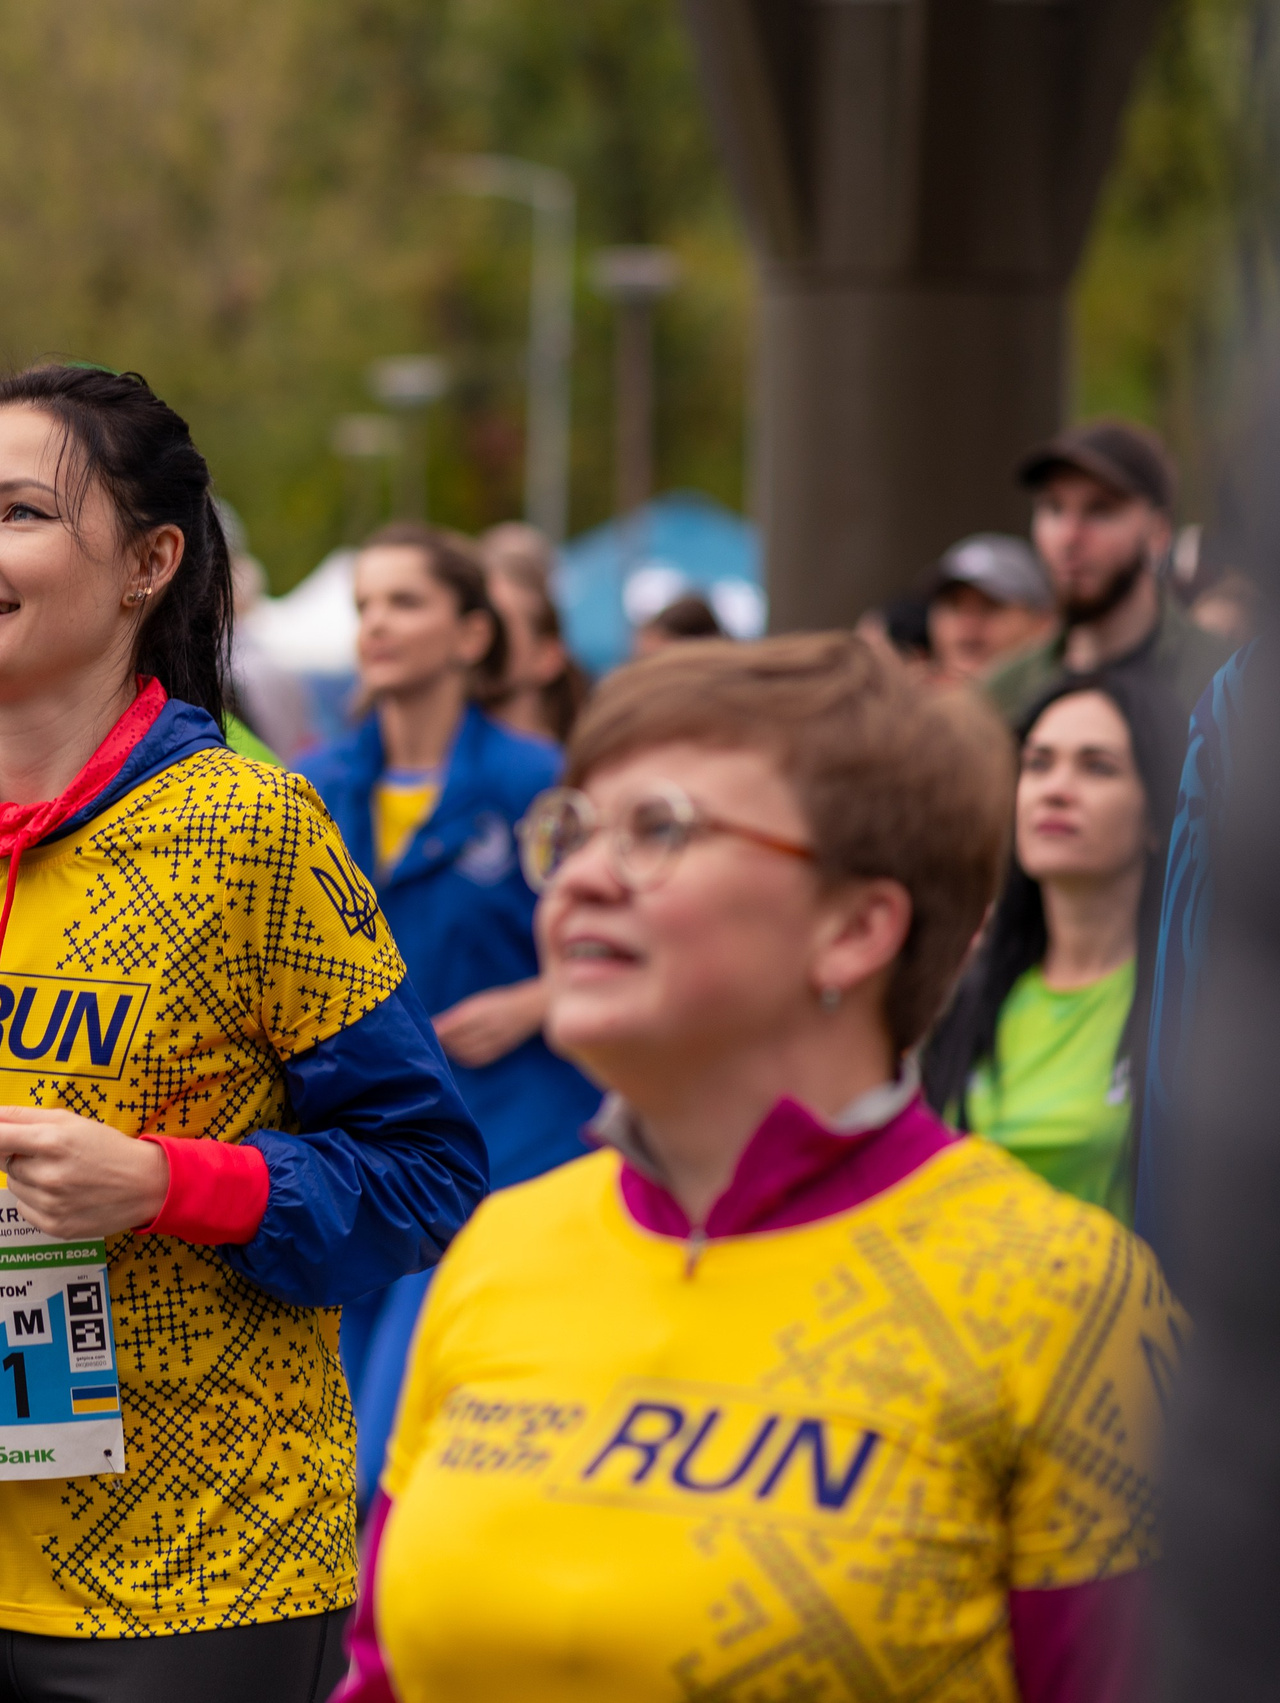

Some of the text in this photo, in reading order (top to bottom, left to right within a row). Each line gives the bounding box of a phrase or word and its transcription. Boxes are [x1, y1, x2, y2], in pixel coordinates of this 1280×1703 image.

[66, 1248, 98, 1259] 2024
[13, 1308, 45, 1336] M
[581, 1401, 882, 1512] RUN
